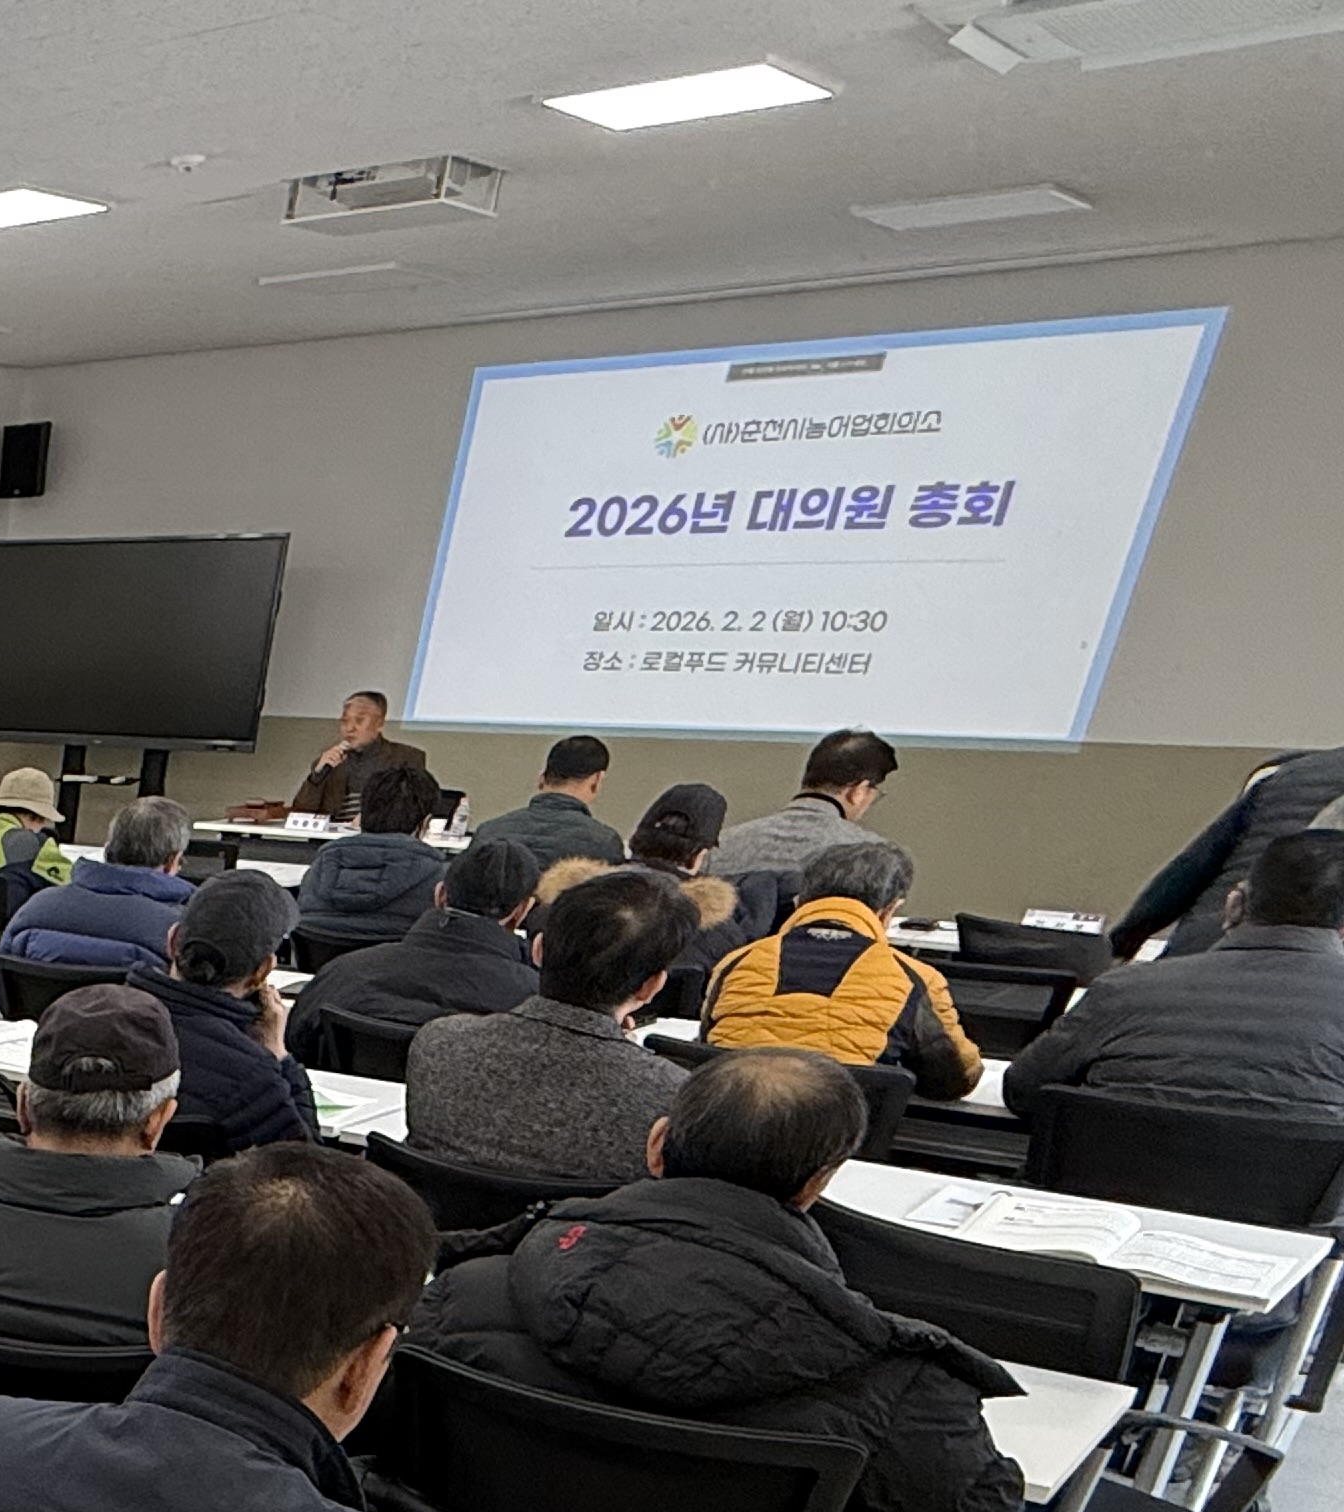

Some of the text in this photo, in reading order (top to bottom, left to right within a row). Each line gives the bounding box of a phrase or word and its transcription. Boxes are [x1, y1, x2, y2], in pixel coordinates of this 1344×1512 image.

[702, 410, 943, 446] (사)춘천시농어업회의소
[563, 479, 1017, 538] 2026년 대의원 총회
[592, 610, 635, 633] 일시
[650, 610, 715, 633] 2026.
[720, 610, 743, 633] 2.
[748, 610, 767, 633] 2
[772, 608, 814, 634] (월)
[820, 610, 889, 633] 10:30
[582, 651, 623, 672] 장소
[639, 651, 729, 673] 로컬푸드
[733, 652, 873, 675] 커뮤니티센터
